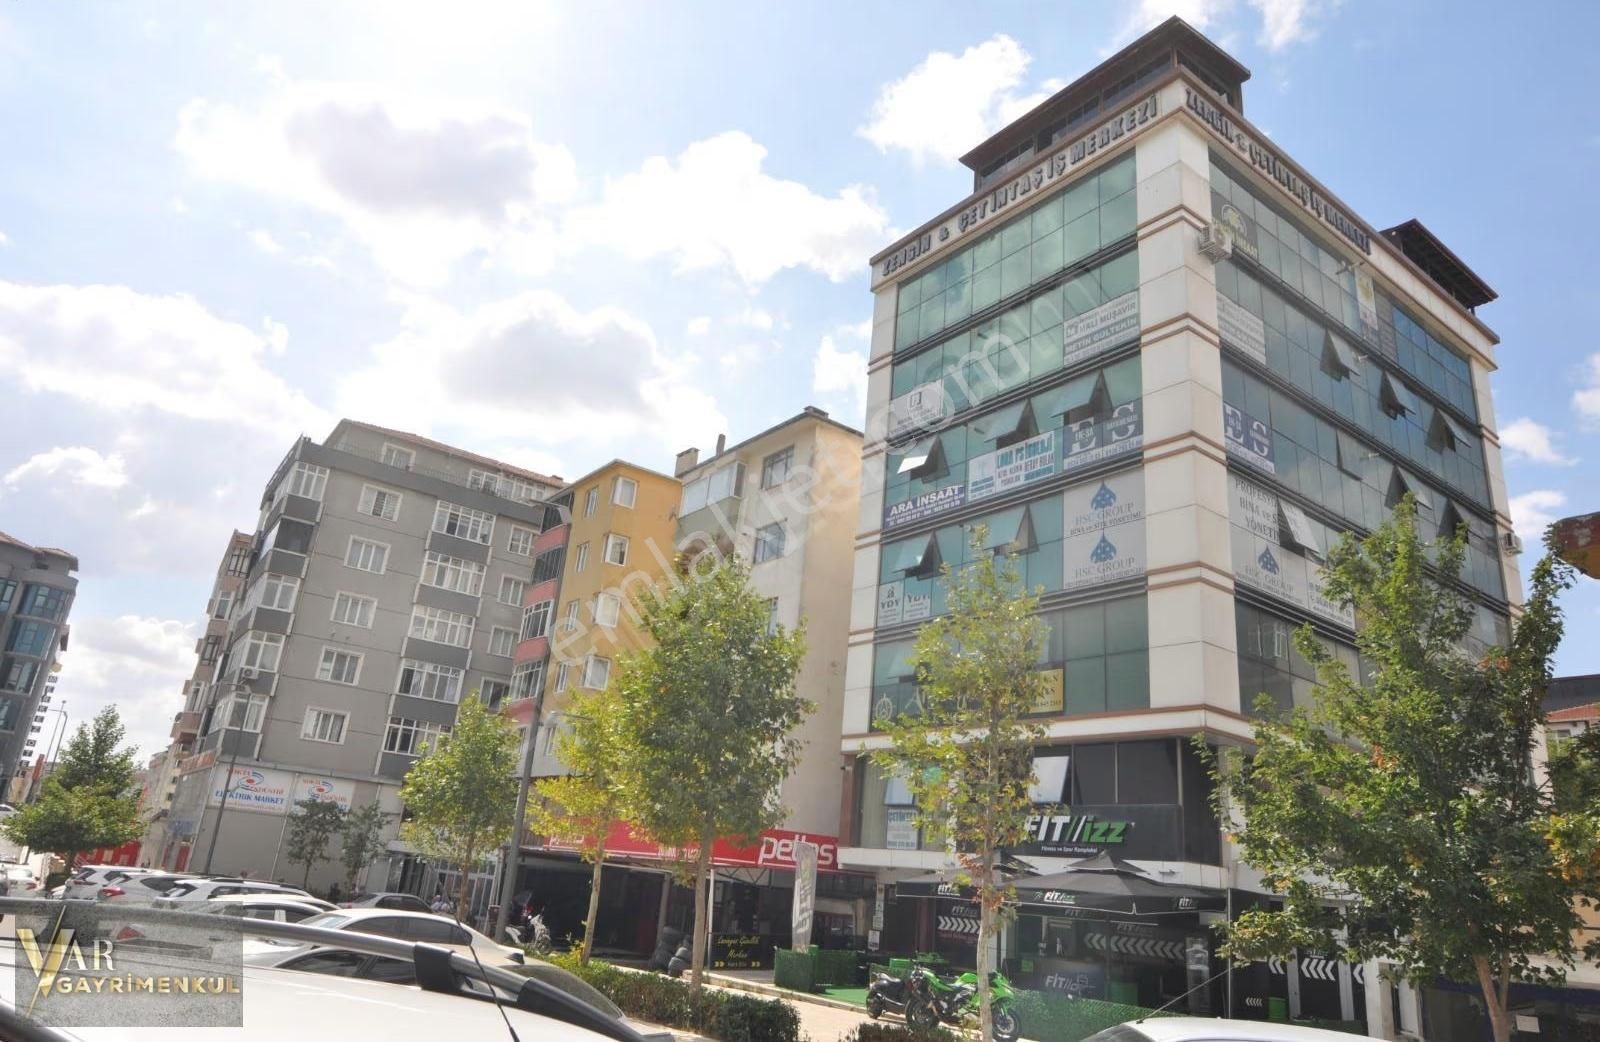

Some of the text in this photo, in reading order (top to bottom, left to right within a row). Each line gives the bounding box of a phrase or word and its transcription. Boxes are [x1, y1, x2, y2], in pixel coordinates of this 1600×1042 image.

[882, 231, 932, 276] ZENGİN
[938, 226, 949, 240] &
[1046, 154, 1067, 181] İŞ
[1070, 94, 1157, 164] MERKEZİ
